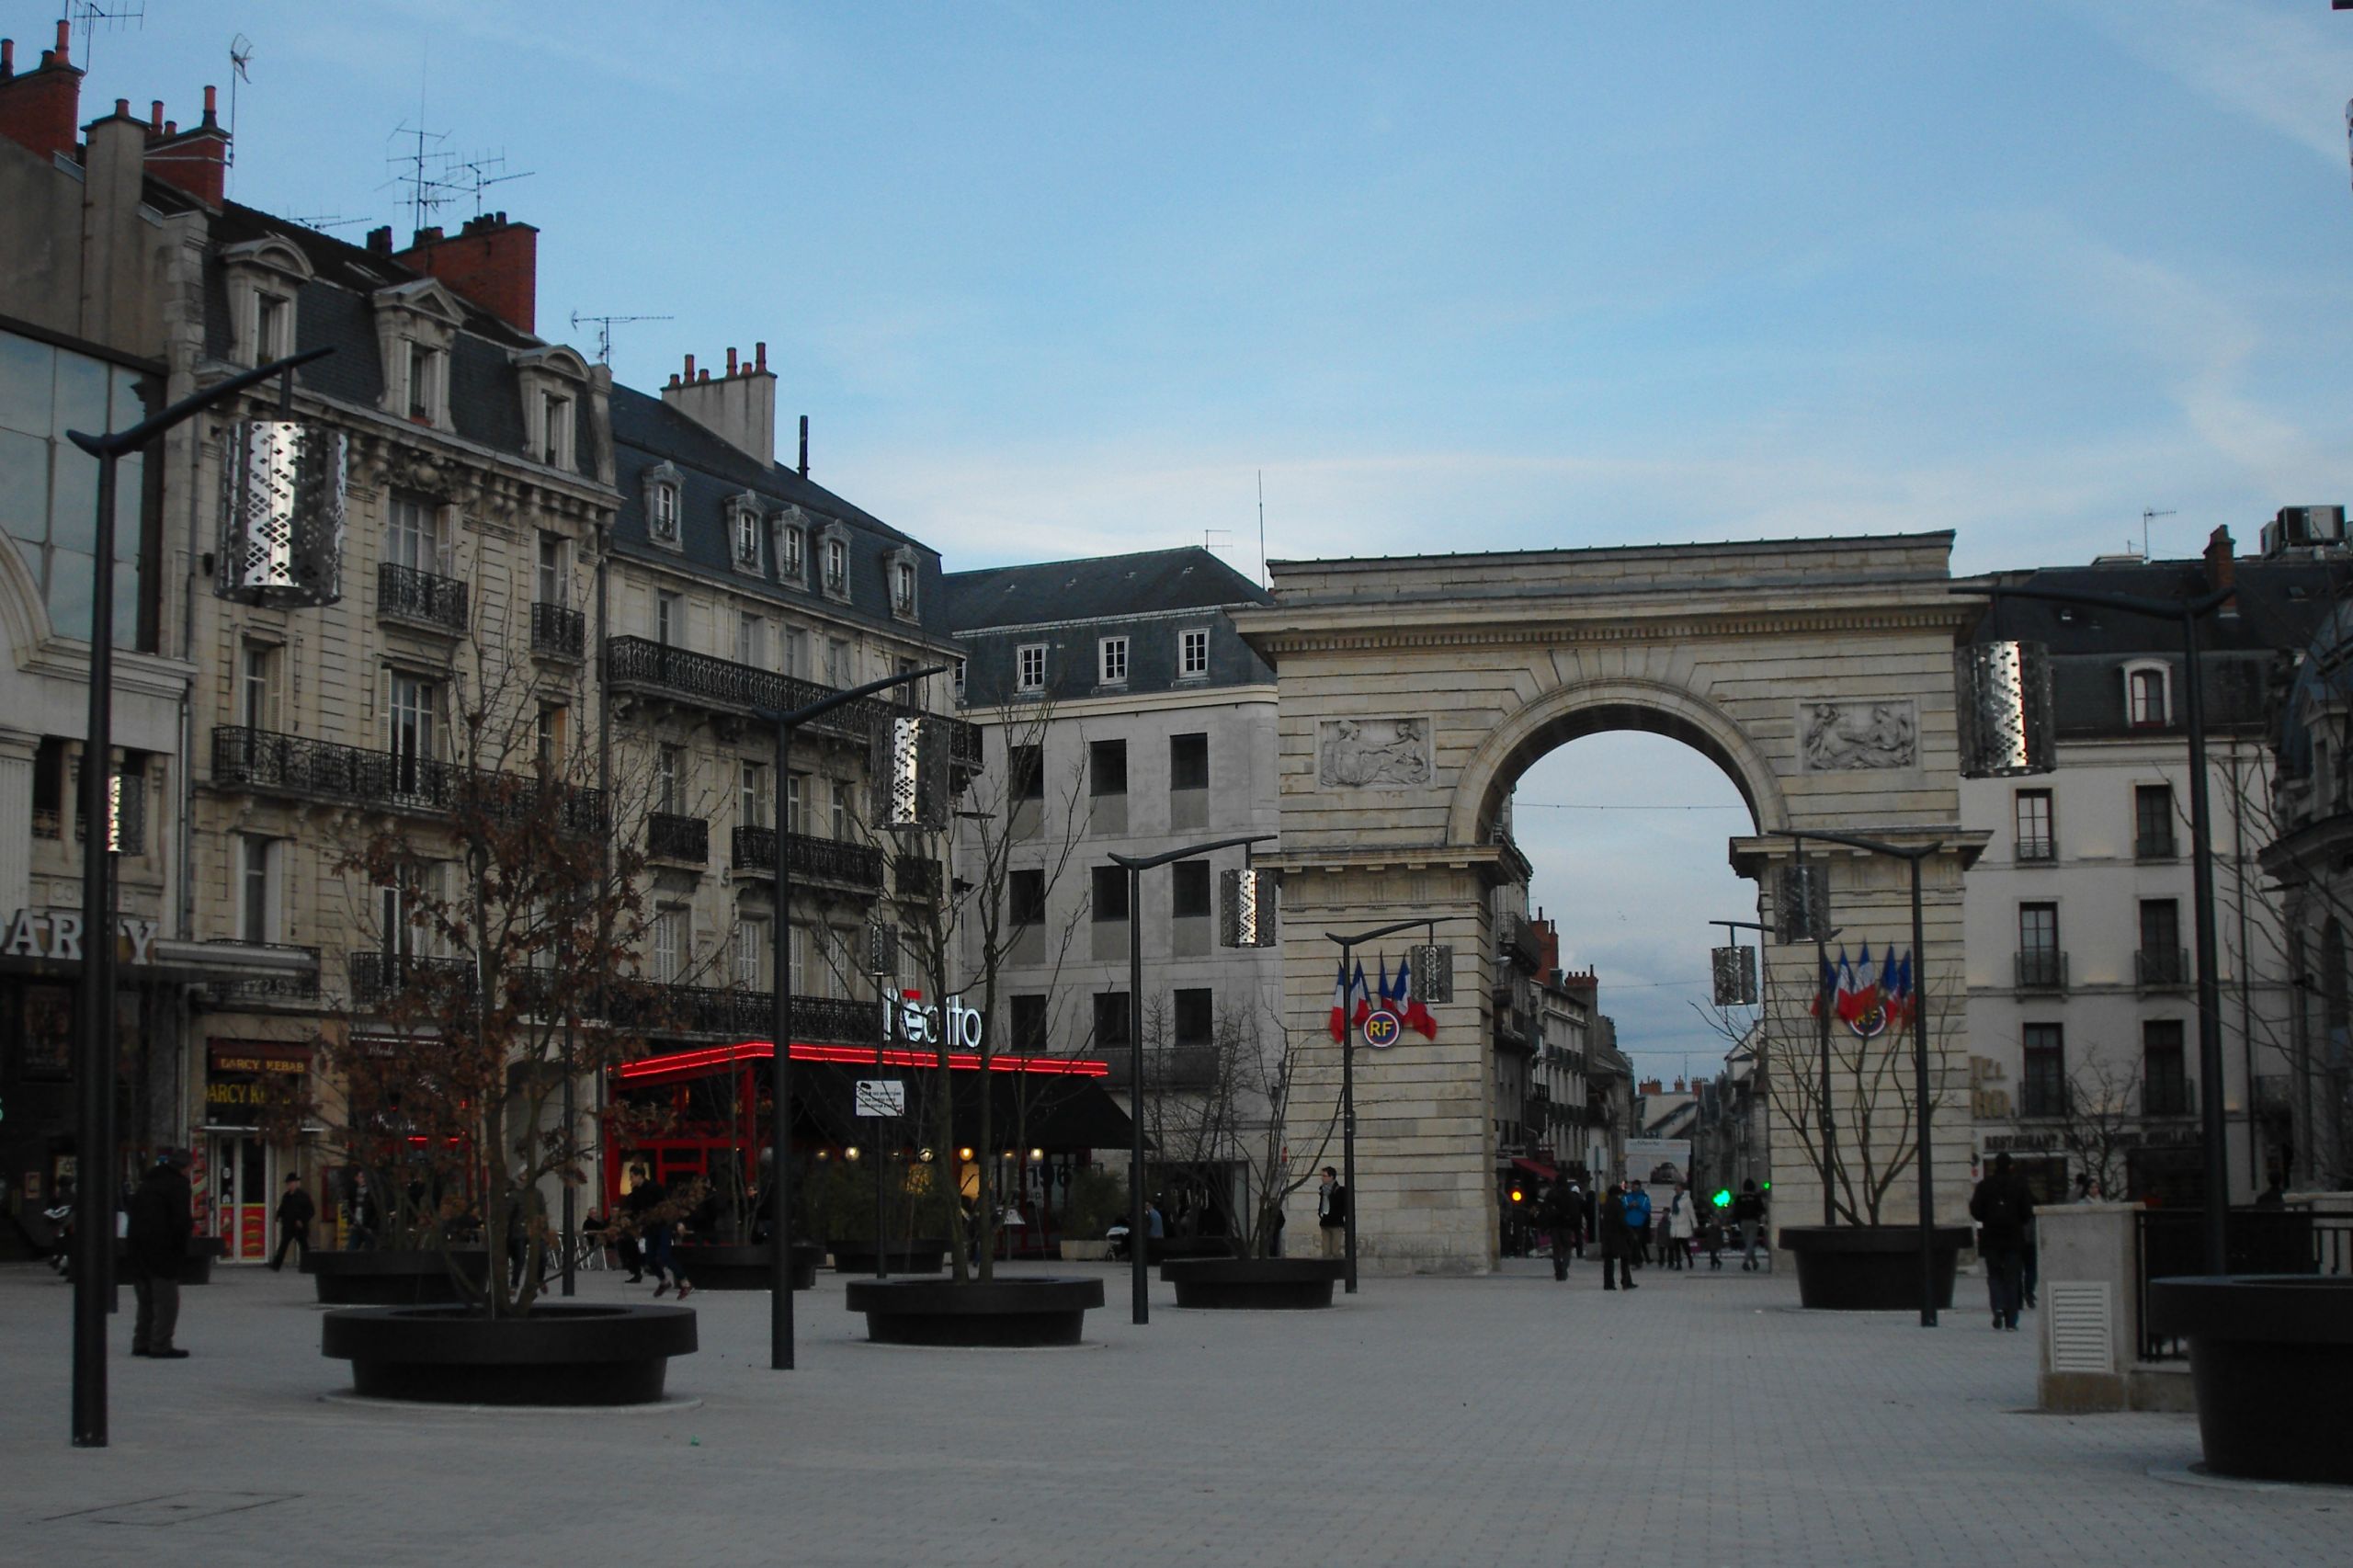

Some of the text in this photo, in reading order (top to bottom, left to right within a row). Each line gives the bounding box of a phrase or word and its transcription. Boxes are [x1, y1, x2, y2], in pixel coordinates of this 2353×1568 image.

[0, 908, 158, 965] ARY
[1369, 1020, 1393, 1037] RF
[266, 1059, 305, 1073] KEBAB
[207, 1085, 247, 1103] ARCY
